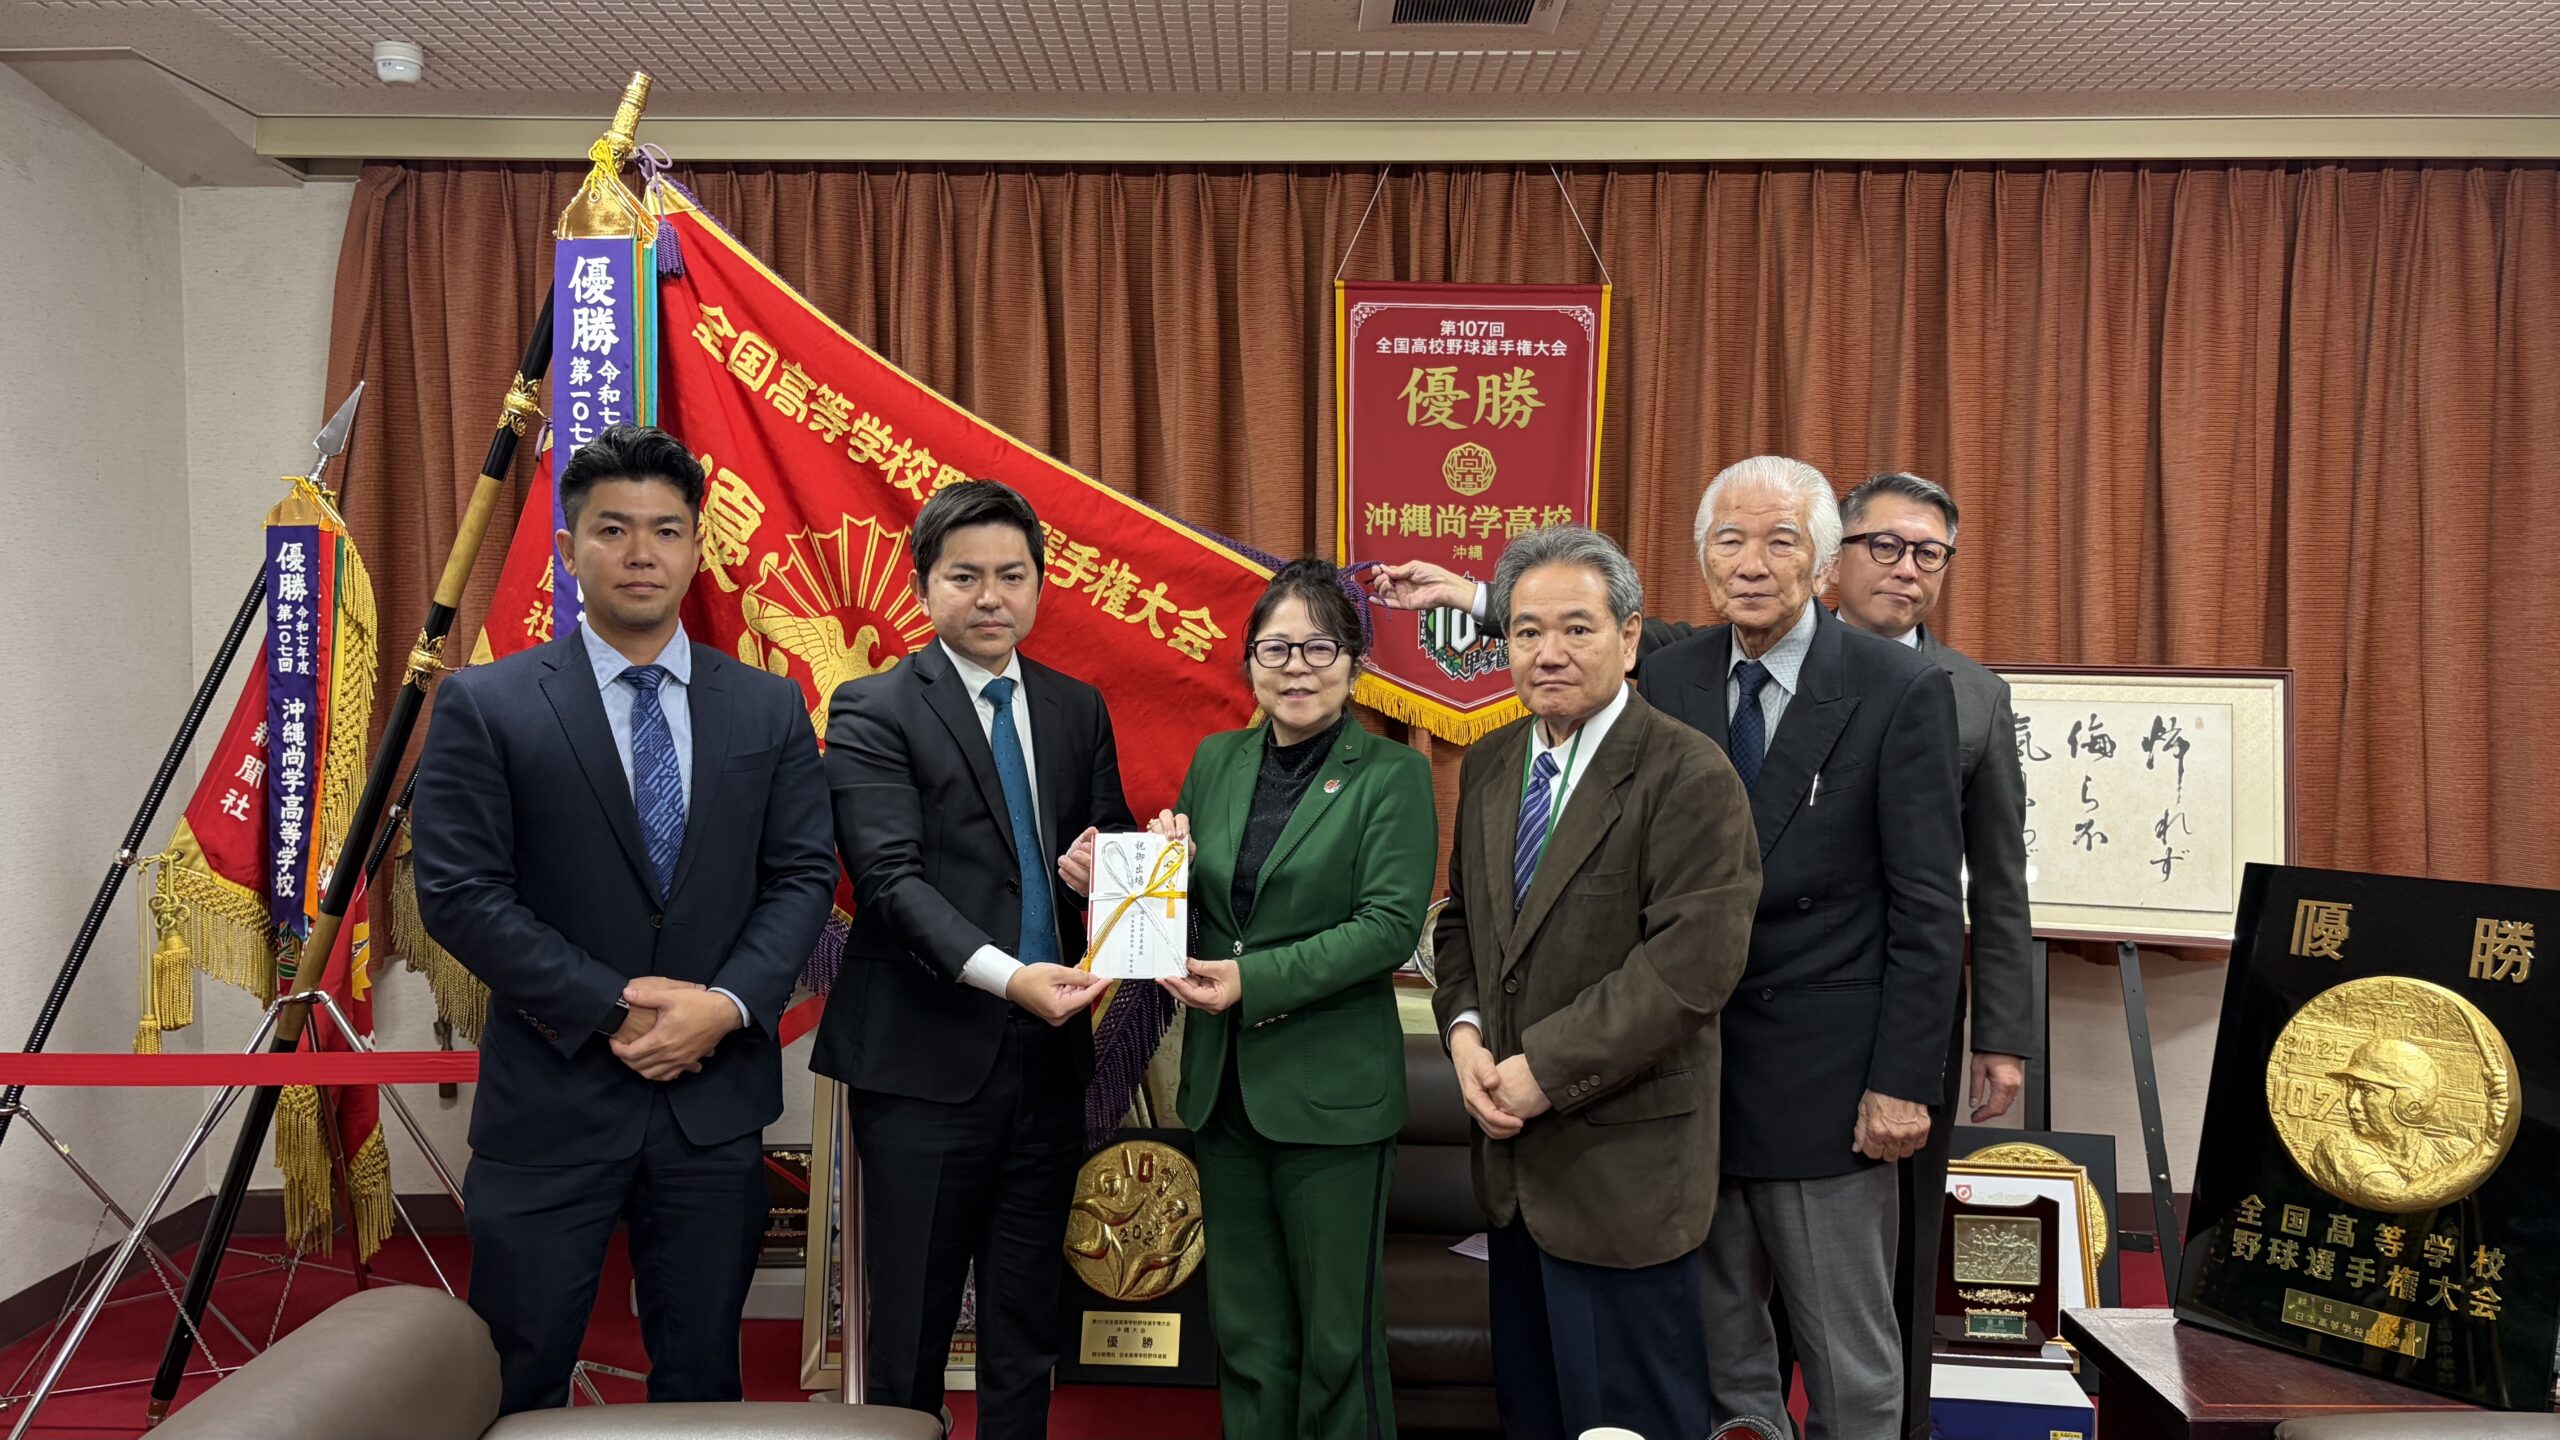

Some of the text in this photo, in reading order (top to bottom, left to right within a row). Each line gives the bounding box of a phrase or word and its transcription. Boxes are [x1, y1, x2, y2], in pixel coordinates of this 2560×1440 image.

[568, 256, 619, 355] 優勝
[1440, 320, 1505, 337] 第107回
[1376, 337, 1568, 357] 全国高校野球選手権大会
[569, 356, 593, 462] 第一〇七
[597, 360, 621, 431] 令和七
[1396, 366, 1546, 430] 優勝
[1364, 502, 1573, 539] 沖縄尚学高校
[276, 541, 308, 602] 優勝
[1452, 545, 1483, 561] 沖縄
[296, 606, 310, 675] 令和七年度
[276, 698, 308, 898] 沖縄尚学高等学校
[2289, 899, 2536, 984] 優勝
[2284, 1033, 2349, 1063] 2025
[2272, 1076, 2341, 1122] 107
[1121, 1147, 1178, 1198] 107
[2231, 1228, 2502, 1321] 野球選手権大会
[1107, 1335, 1153, 1349] 優勝
